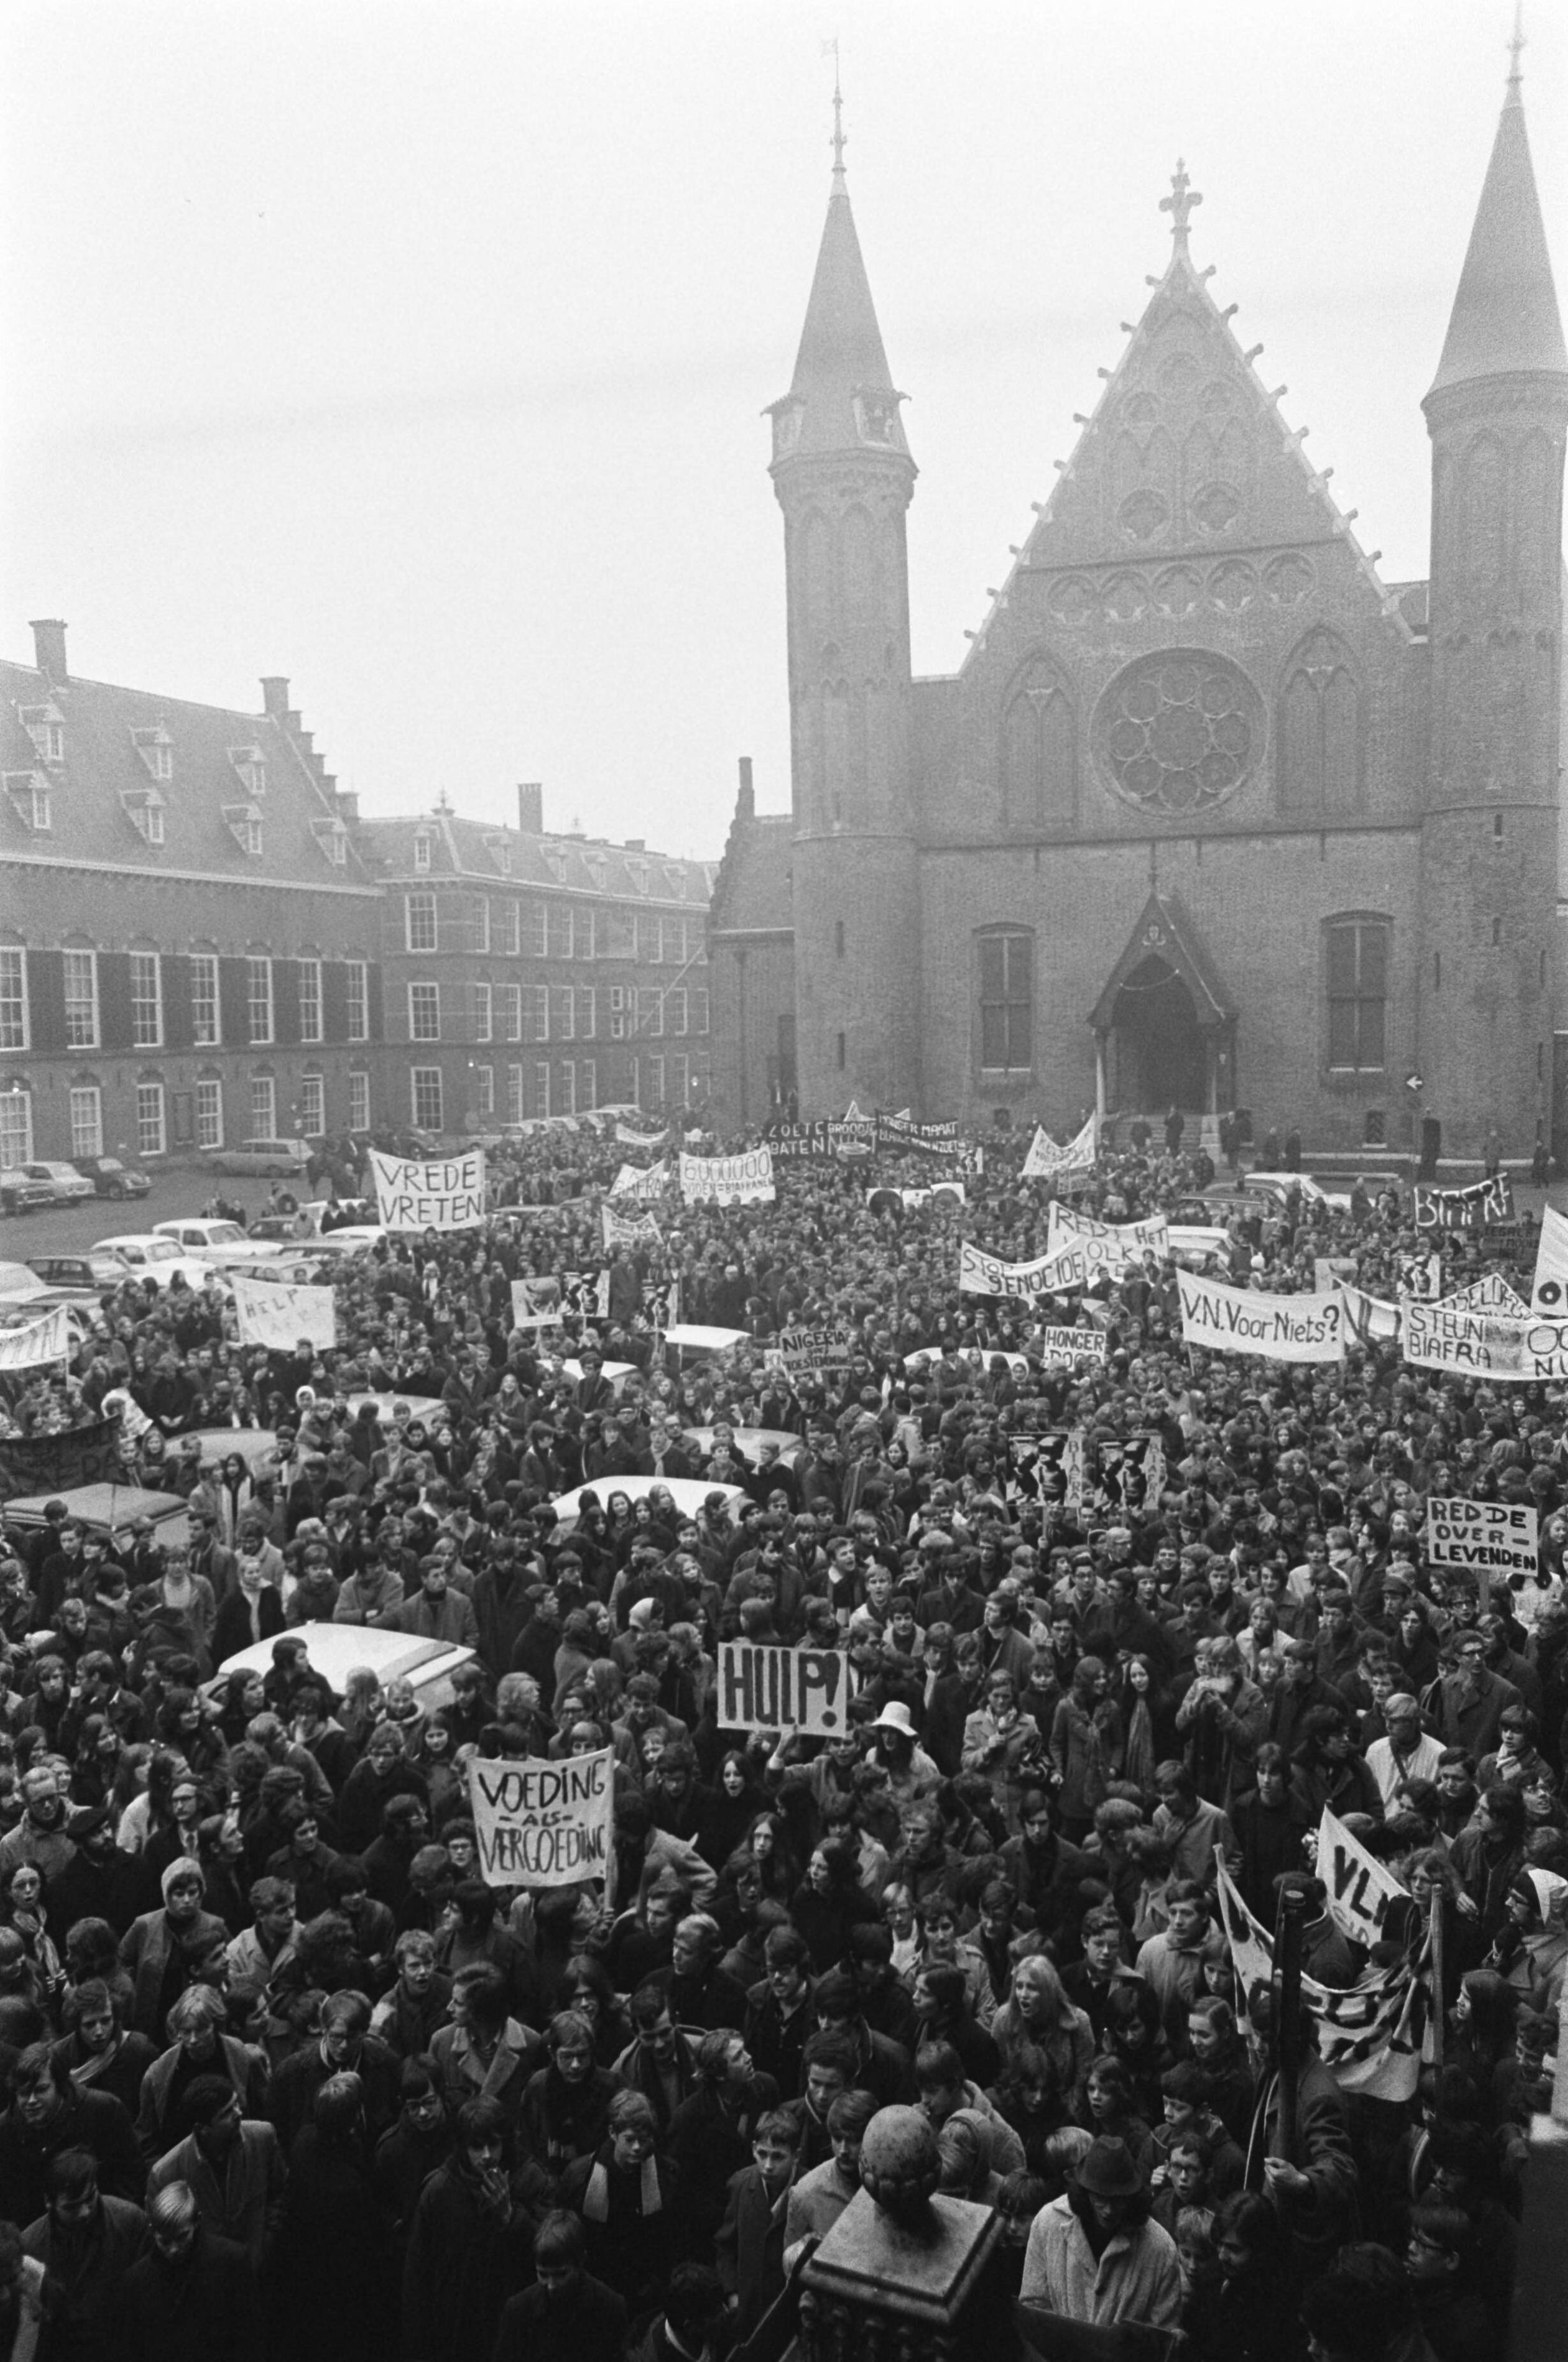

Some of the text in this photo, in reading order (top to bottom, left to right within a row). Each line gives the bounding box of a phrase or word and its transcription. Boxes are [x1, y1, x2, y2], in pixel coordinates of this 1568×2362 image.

[769, 1121, 824, 1138] ZOETE
[771, 1136, 824, 1155] BATEN
[377, 1159, 477, 1192] VREDE
[684, 1150, 770, 1182] 6000000
[381, 1192, 481, 1224] VRETEN
[963, 1248, 1013, 1275] STOP
[1274, 1305, 1340, 1342] Niets?
[1409, 1307, 1484, 1343] STEUN
[782, 1330, 847, 1353] NIGERIA
[1046, 1328, 1106, 1352] HONGER
[1431, 1500, 1527, 1529] RED DE
[1433, 1543, 1537, 1571] LEVENDEN
[724, 1645, 841, 1728] HULP!
